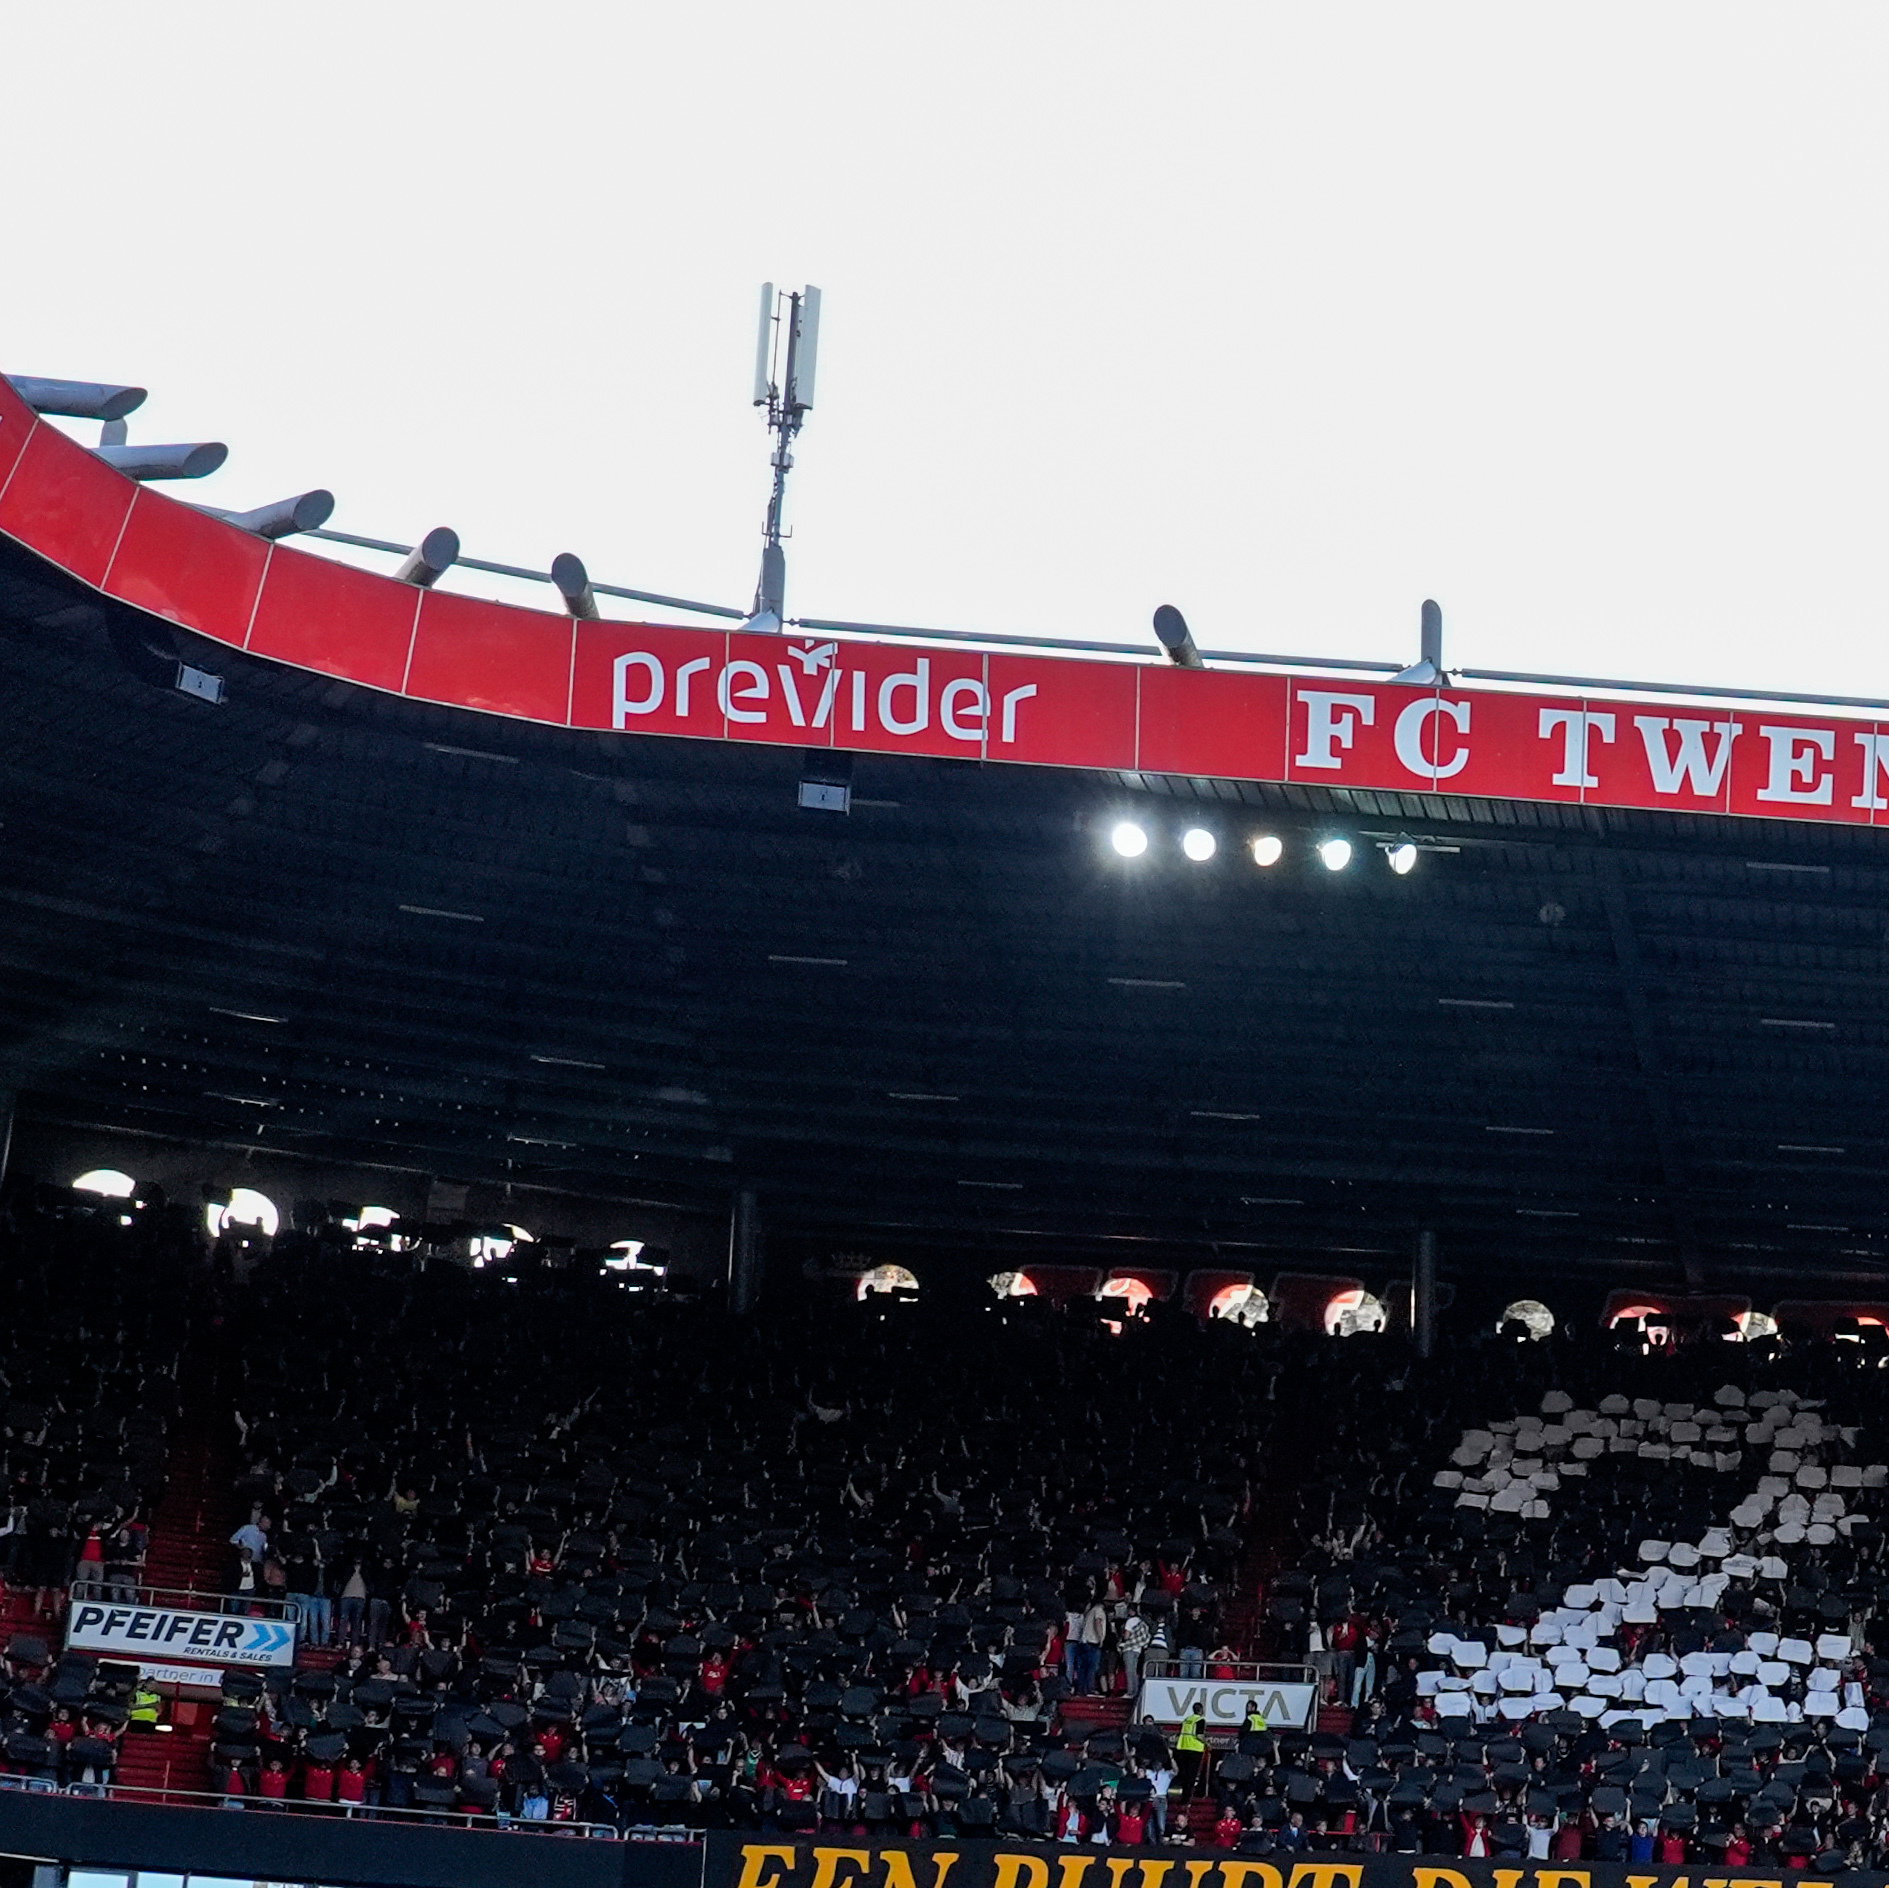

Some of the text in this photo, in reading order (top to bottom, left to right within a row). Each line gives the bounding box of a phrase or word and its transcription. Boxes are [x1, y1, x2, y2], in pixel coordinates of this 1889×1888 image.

[612, 641, 1038, 743] previder
[1295, 690, 1471, 780] FC
[73, 1607, 245, 1649] PFEIFER
[183, 1647, 229, 1659] RENTALS
[240, 1652, 272, 1662] SALES
[1167, 1686, 1291, 1720] VICTA
